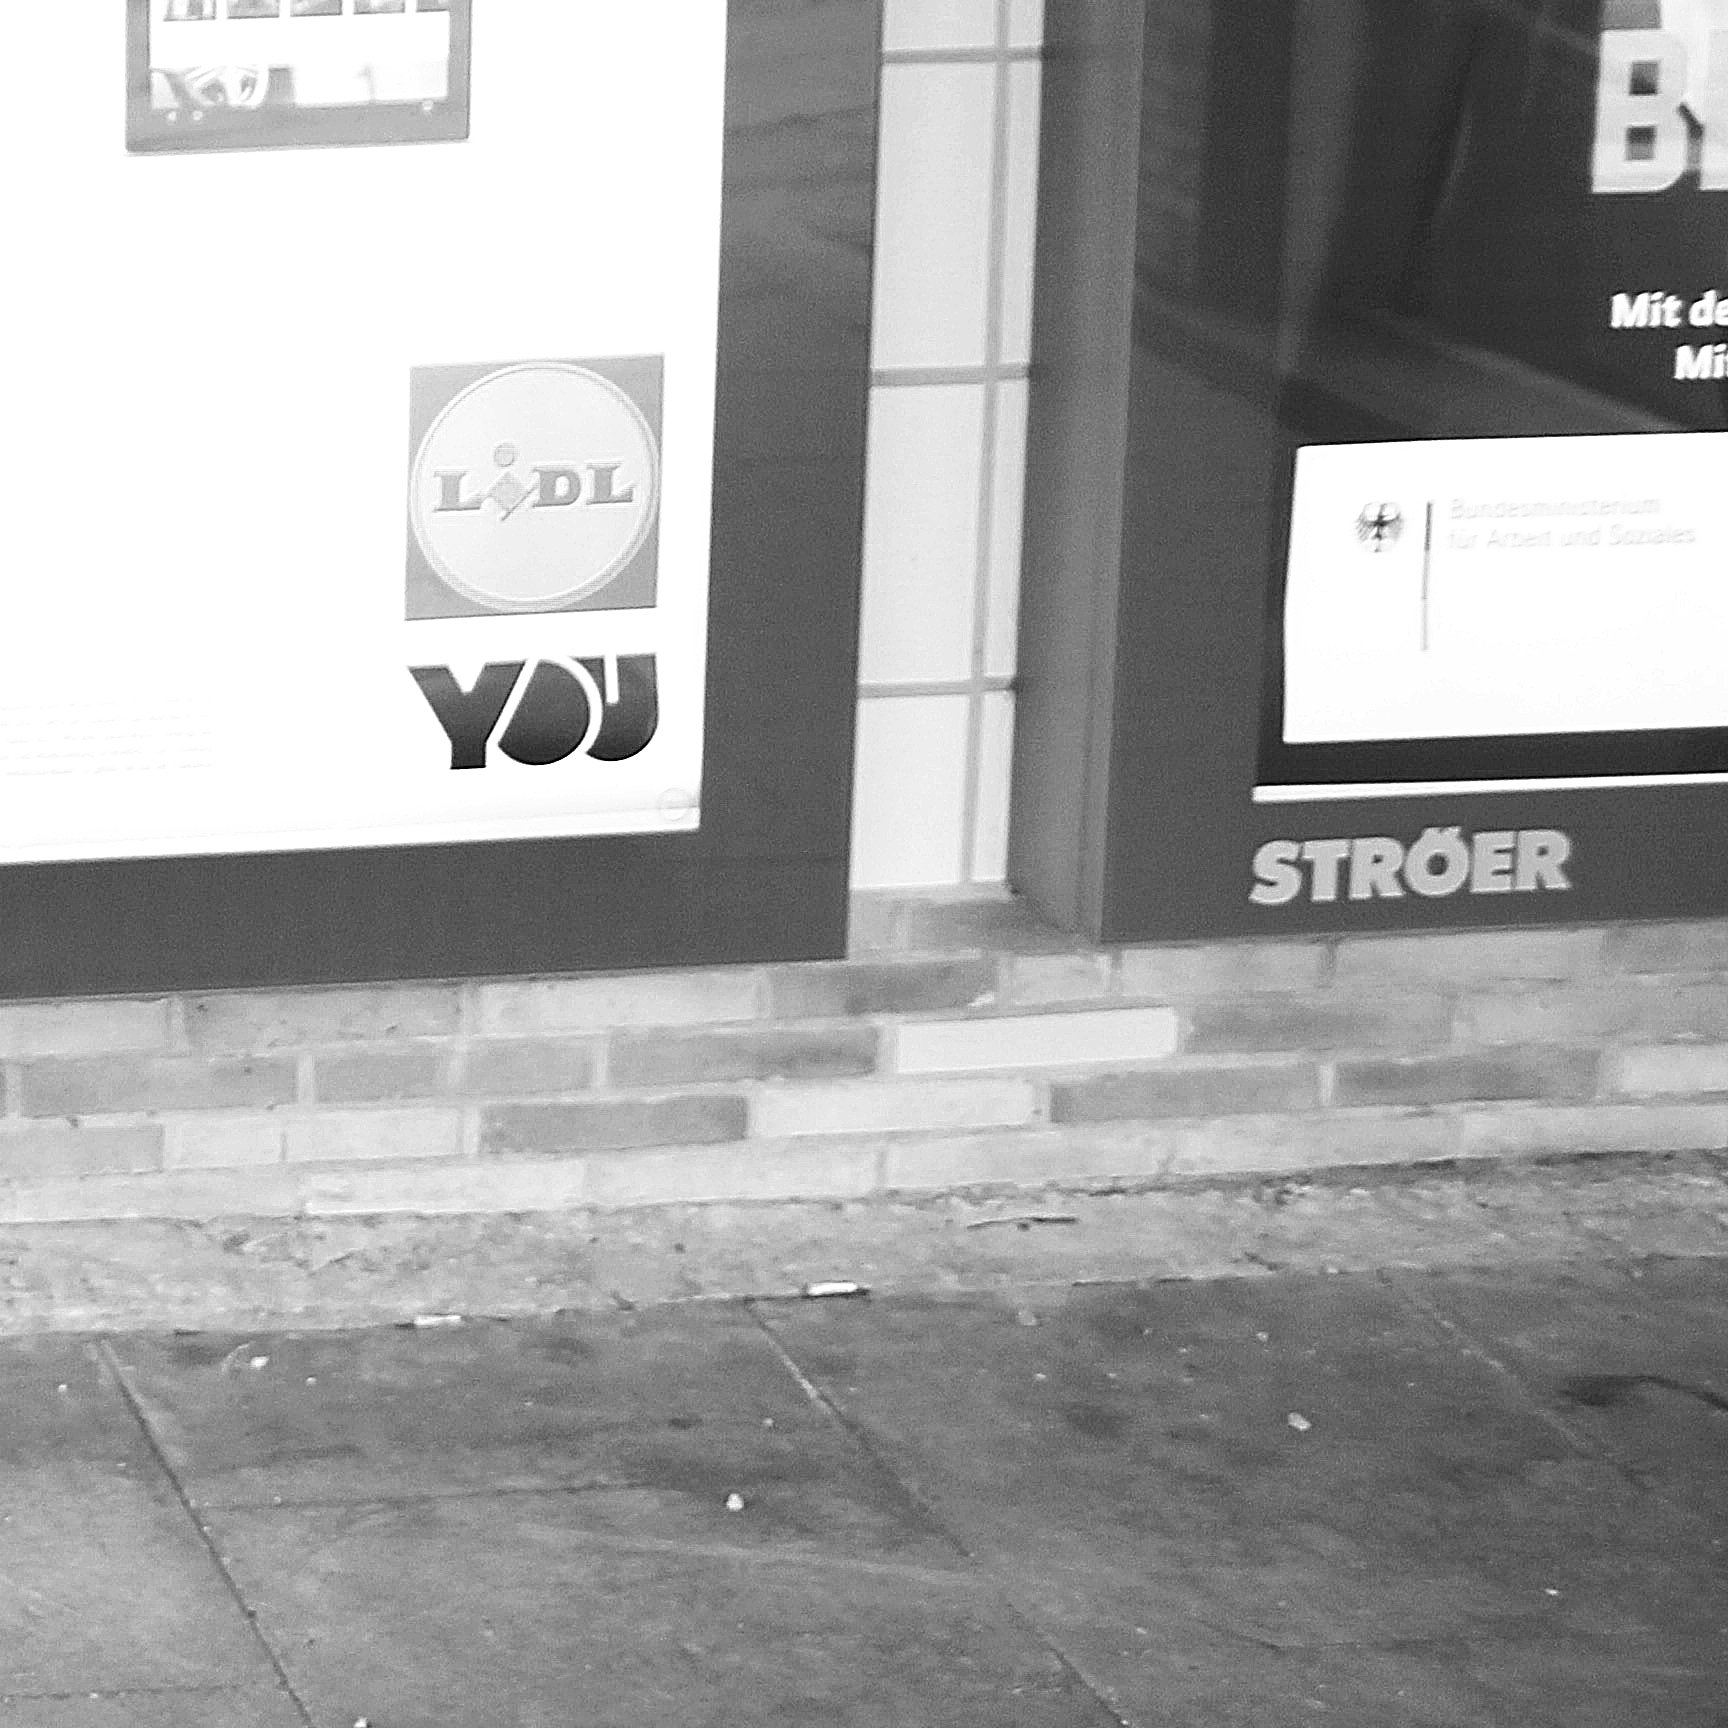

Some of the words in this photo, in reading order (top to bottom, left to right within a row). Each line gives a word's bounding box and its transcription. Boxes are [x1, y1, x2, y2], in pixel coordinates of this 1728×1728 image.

[1610, 291, 1682, 328] Mit
[1674, 343, 1728, 380] Mi
[1248, 826, 1572, 903] STRÖER
